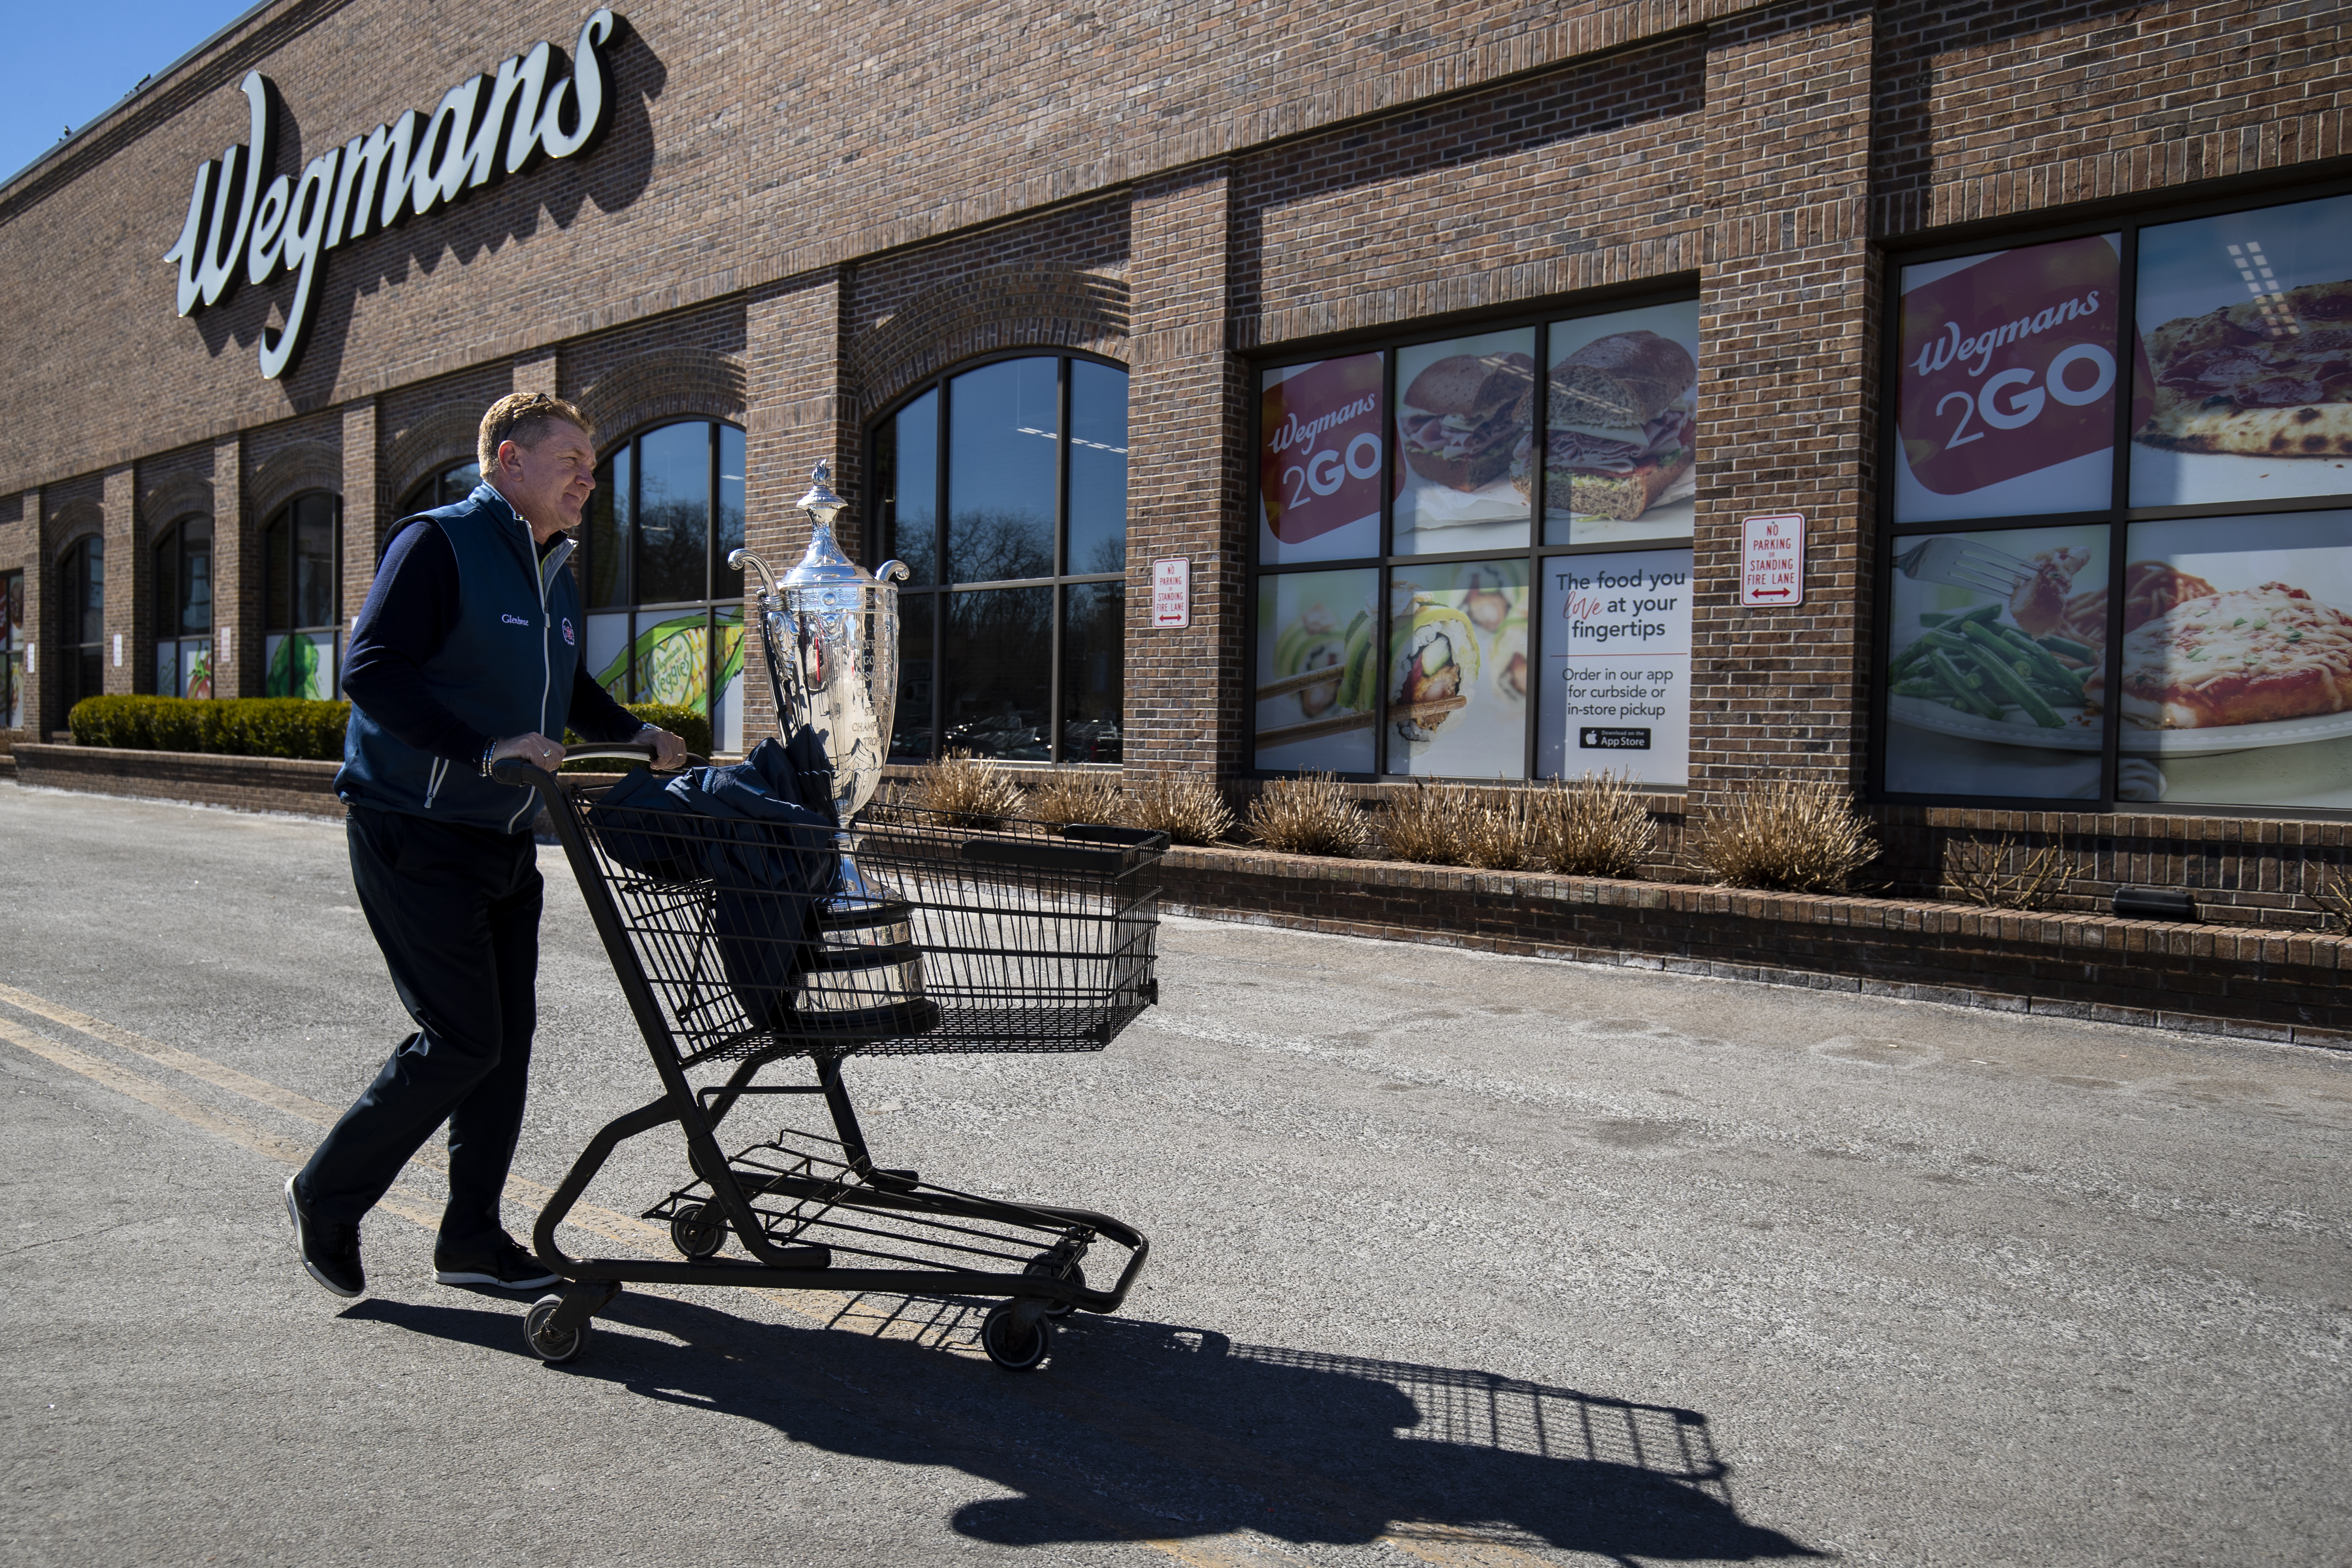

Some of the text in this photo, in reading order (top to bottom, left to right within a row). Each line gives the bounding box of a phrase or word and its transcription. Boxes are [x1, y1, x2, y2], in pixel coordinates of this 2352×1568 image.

[162, 8, 614, 379] Wegmans
[1908, 290, 2099, 377] Wegmans
[1936, 343, 2117, 450] 2GO
[1267, 393, 1375, 455] Wegmans
[1283, 433, 1382, 510] 2GO
[1766, 524, 1779, 536] NO
[1753, 538, 1791, 550] PARKING
[1167, 565, 1175, 575] NO
[1750, 558, 1793, 571] STANDING
[1160, 576, 1182, 586] PARKING
[1556, 569, 1685, 592] The food you
[1747, 572, 1795, 585] FIRE LANE
[1158, 592, 1183, 601] STANDING
[1156, 603, 1184, 611] FIRE LANE
[1563, 591, 1677, 619] love at your
[502, 614, 529, 626] Glenbrae
[1572, 619, 1666, 642] fingertips
[1563, 667, 1673, 684] Order in our app
[1568, 684, 1666, 698] for curbside or
[1568, 702, 1666, 720] in-store pickup
[1601, 737, 1644, 748] App Store
